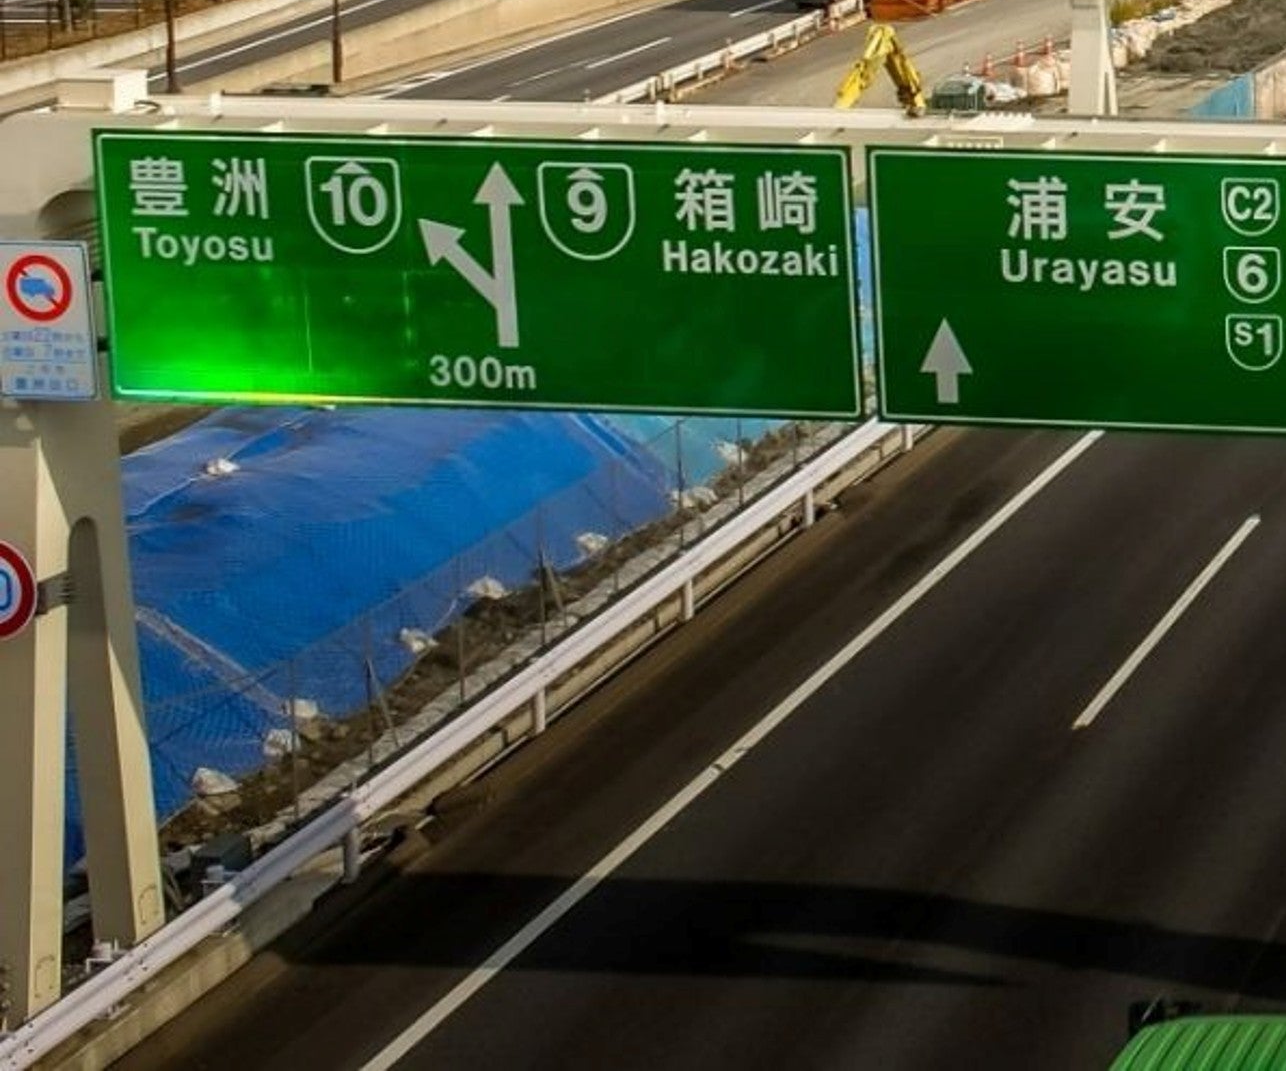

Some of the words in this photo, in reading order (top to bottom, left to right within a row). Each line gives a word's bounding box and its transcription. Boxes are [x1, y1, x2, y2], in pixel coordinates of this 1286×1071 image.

[130, 157, 267, 218] 豊洲
[320, 176, 388, 226] 10
[567, 179, 608, 233] 9
[675, 169, 817, 233] 箱崎
[1227, 186, 1273, 221] C2
[1008, 177, 1165, 240] 浦安
[134, 227, 272, 264] Toyosu
[664, 241, 837, 275] Hakozaki
[1002, 249, 1176, 290] Urayasu
[1236, 255, 1268, 294] 6
[1234, 322, 1275, 356] S1
[431, 356, 535, 388] 300m
